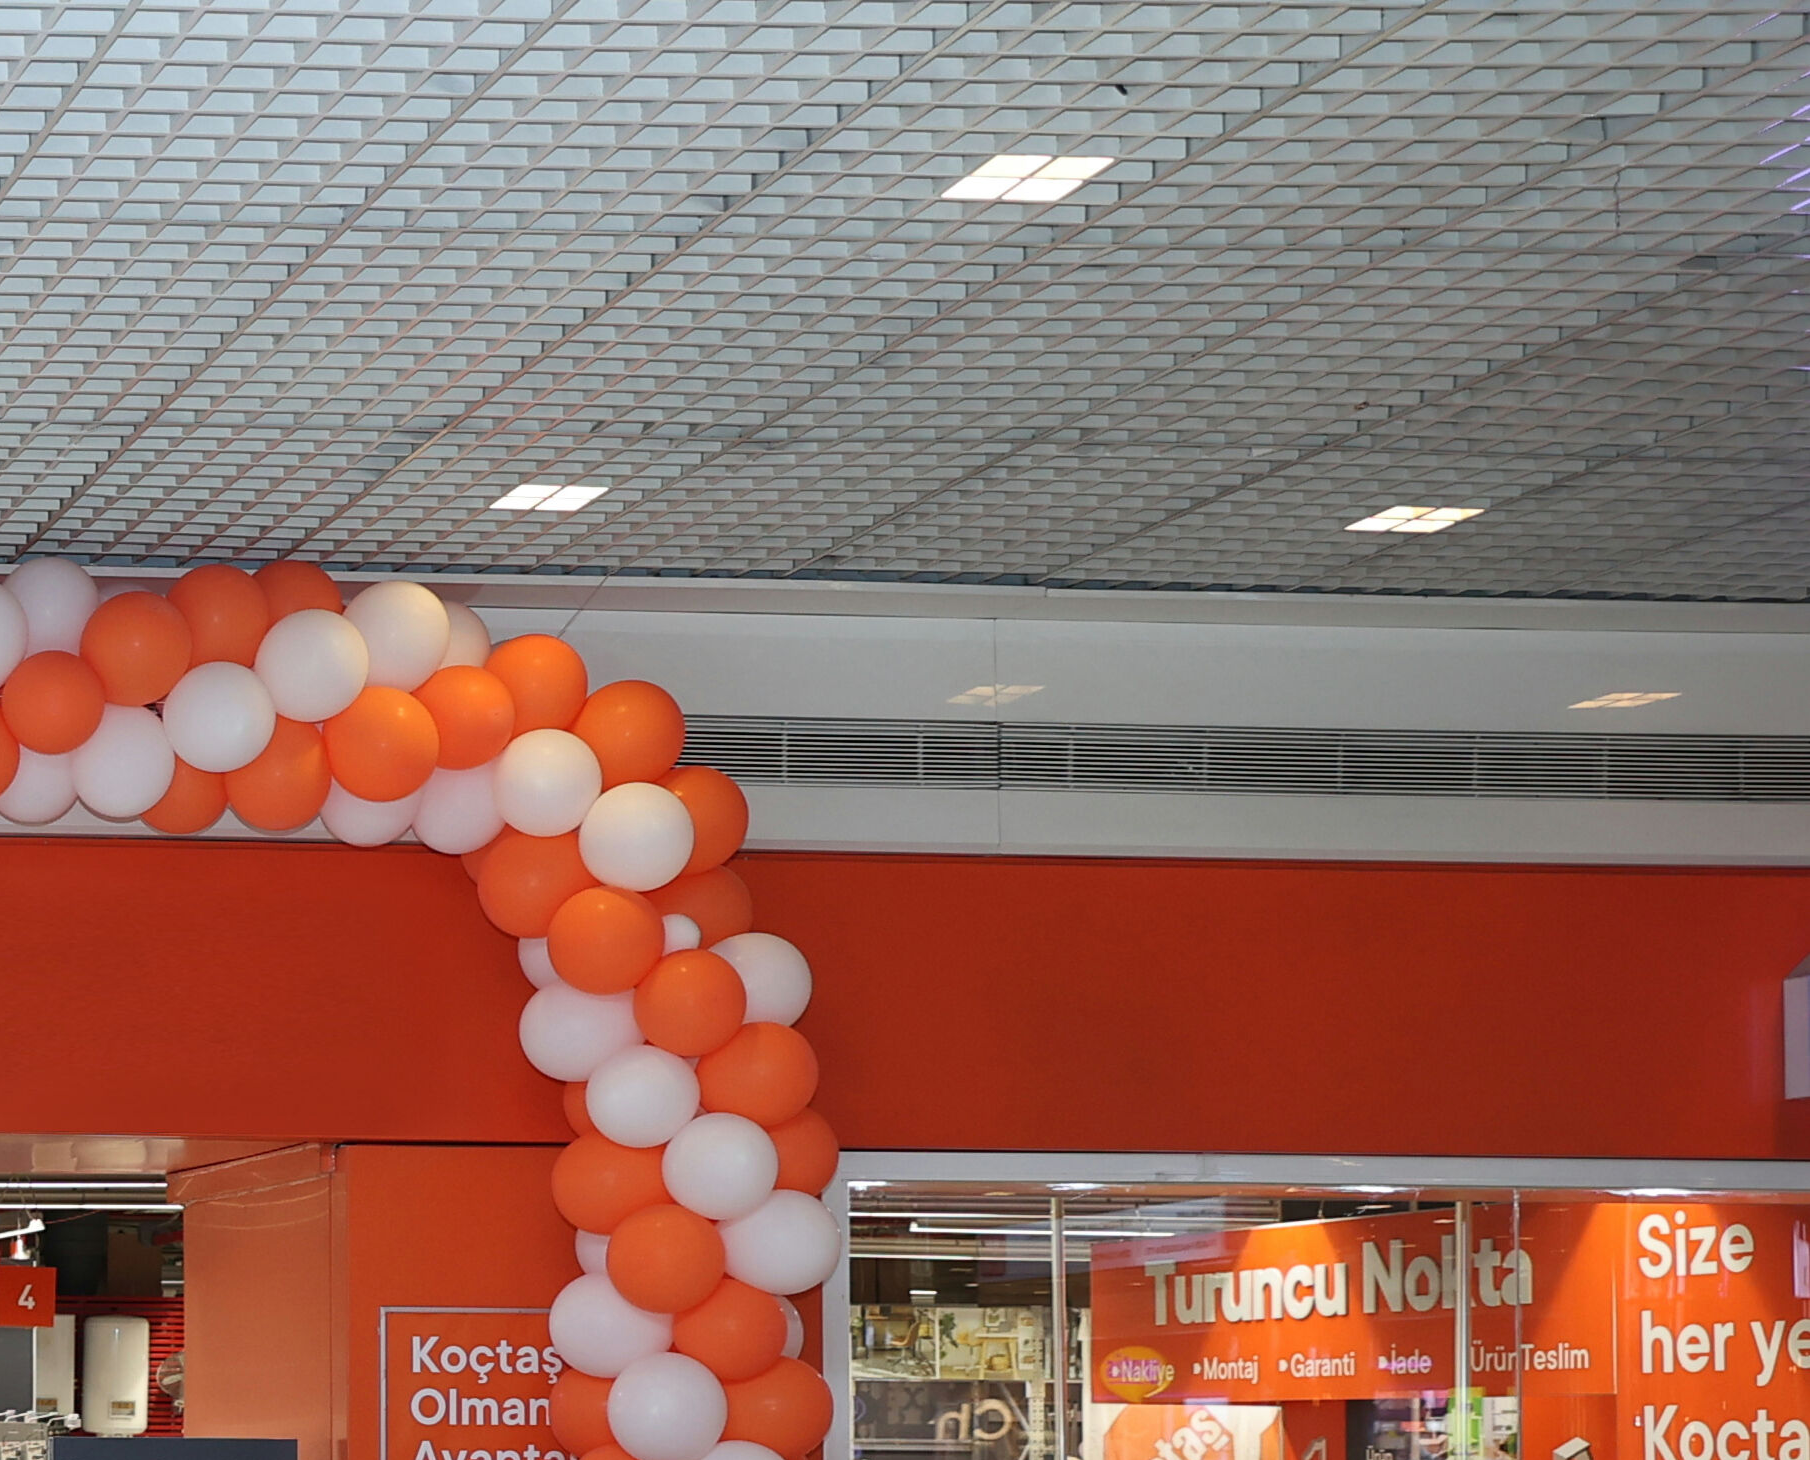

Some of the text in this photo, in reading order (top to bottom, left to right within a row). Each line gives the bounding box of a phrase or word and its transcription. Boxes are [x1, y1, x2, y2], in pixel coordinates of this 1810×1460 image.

[1638, 1210, 1754, 1279] Size
[17, 1284, 36, 1310] 4
[1144, 1259, 1349, 1326] Turuncu
[412, 1335, 563, 1384] Koçtaş
[1121, 1361, 1174, 1387] Nakliye
[1203, 1356, 1258, 1384] Montaj
[1290, 1352, 1355, 1378] Garanti
[1520, 1342, 1589, 1371] Teslim
[1641, 1309, 1735, 1374] her
[410, 1387, 551, 1426] Olman
